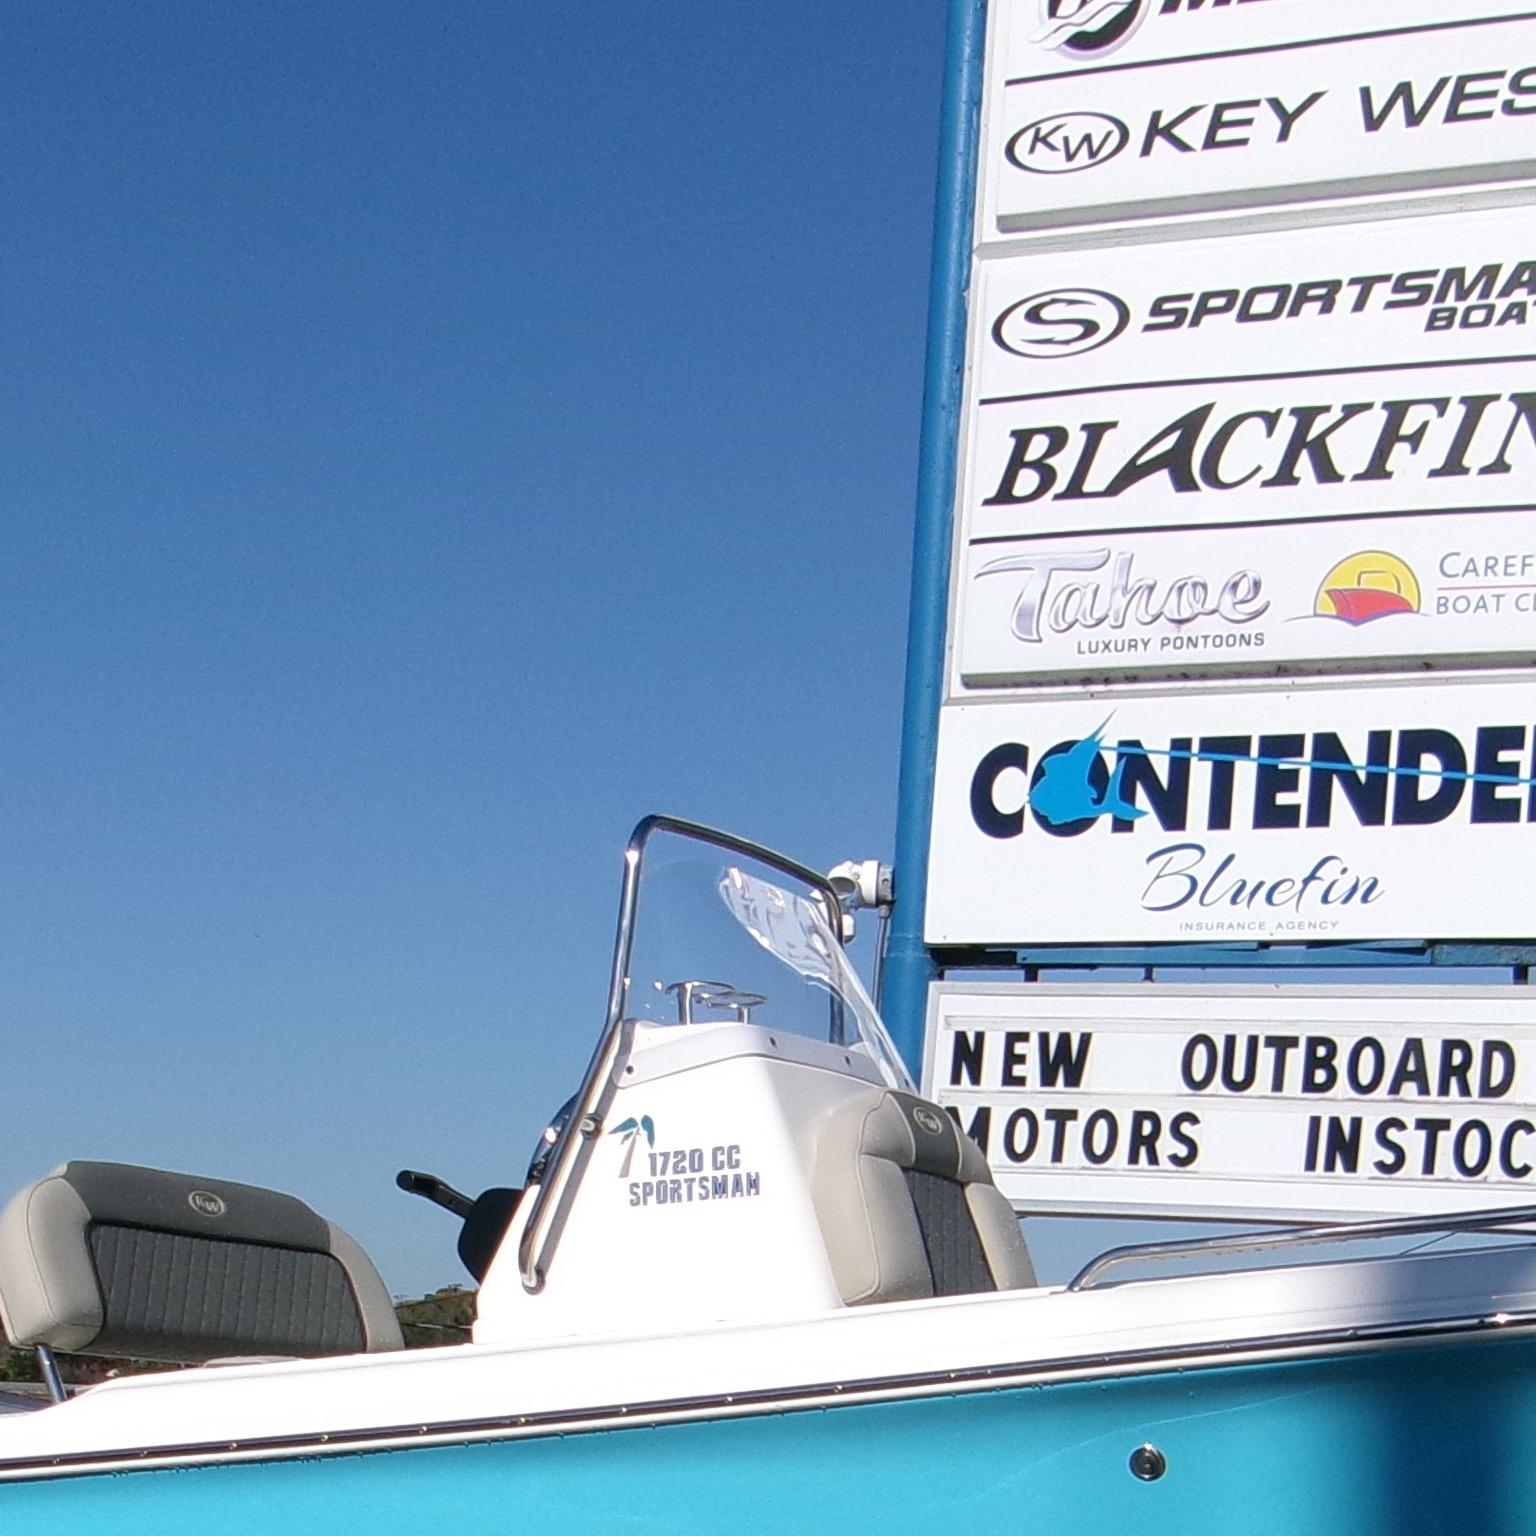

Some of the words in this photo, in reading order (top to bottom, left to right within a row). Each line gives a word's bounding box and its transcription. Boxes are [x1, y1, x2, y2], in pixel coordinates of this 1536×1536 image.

[1139, 90, 1328, 158] KEY
[973, 547, 1271, 643] Tahoe
[1436, 593, 1506, 615] BOAT
[1077, 637, 1152, 655] LUXURY
[1160, 632, 1265, 651] PONTOONS
[1140, 842, 1386, 914] Bluefin
[1179, 921, 1267, 932] INSURANCE
[1275, 920, 1340, 931] AGENCY
[949, 1031, 1094, 1089] NEW
[1180, 1033, 1517, 1099] OUTBOARD
[648, 1148, 704, 1177] 1720
[711, 1144, 741, 1171] CC
[629, 1171, 760, 1207] SPORTSMAN
